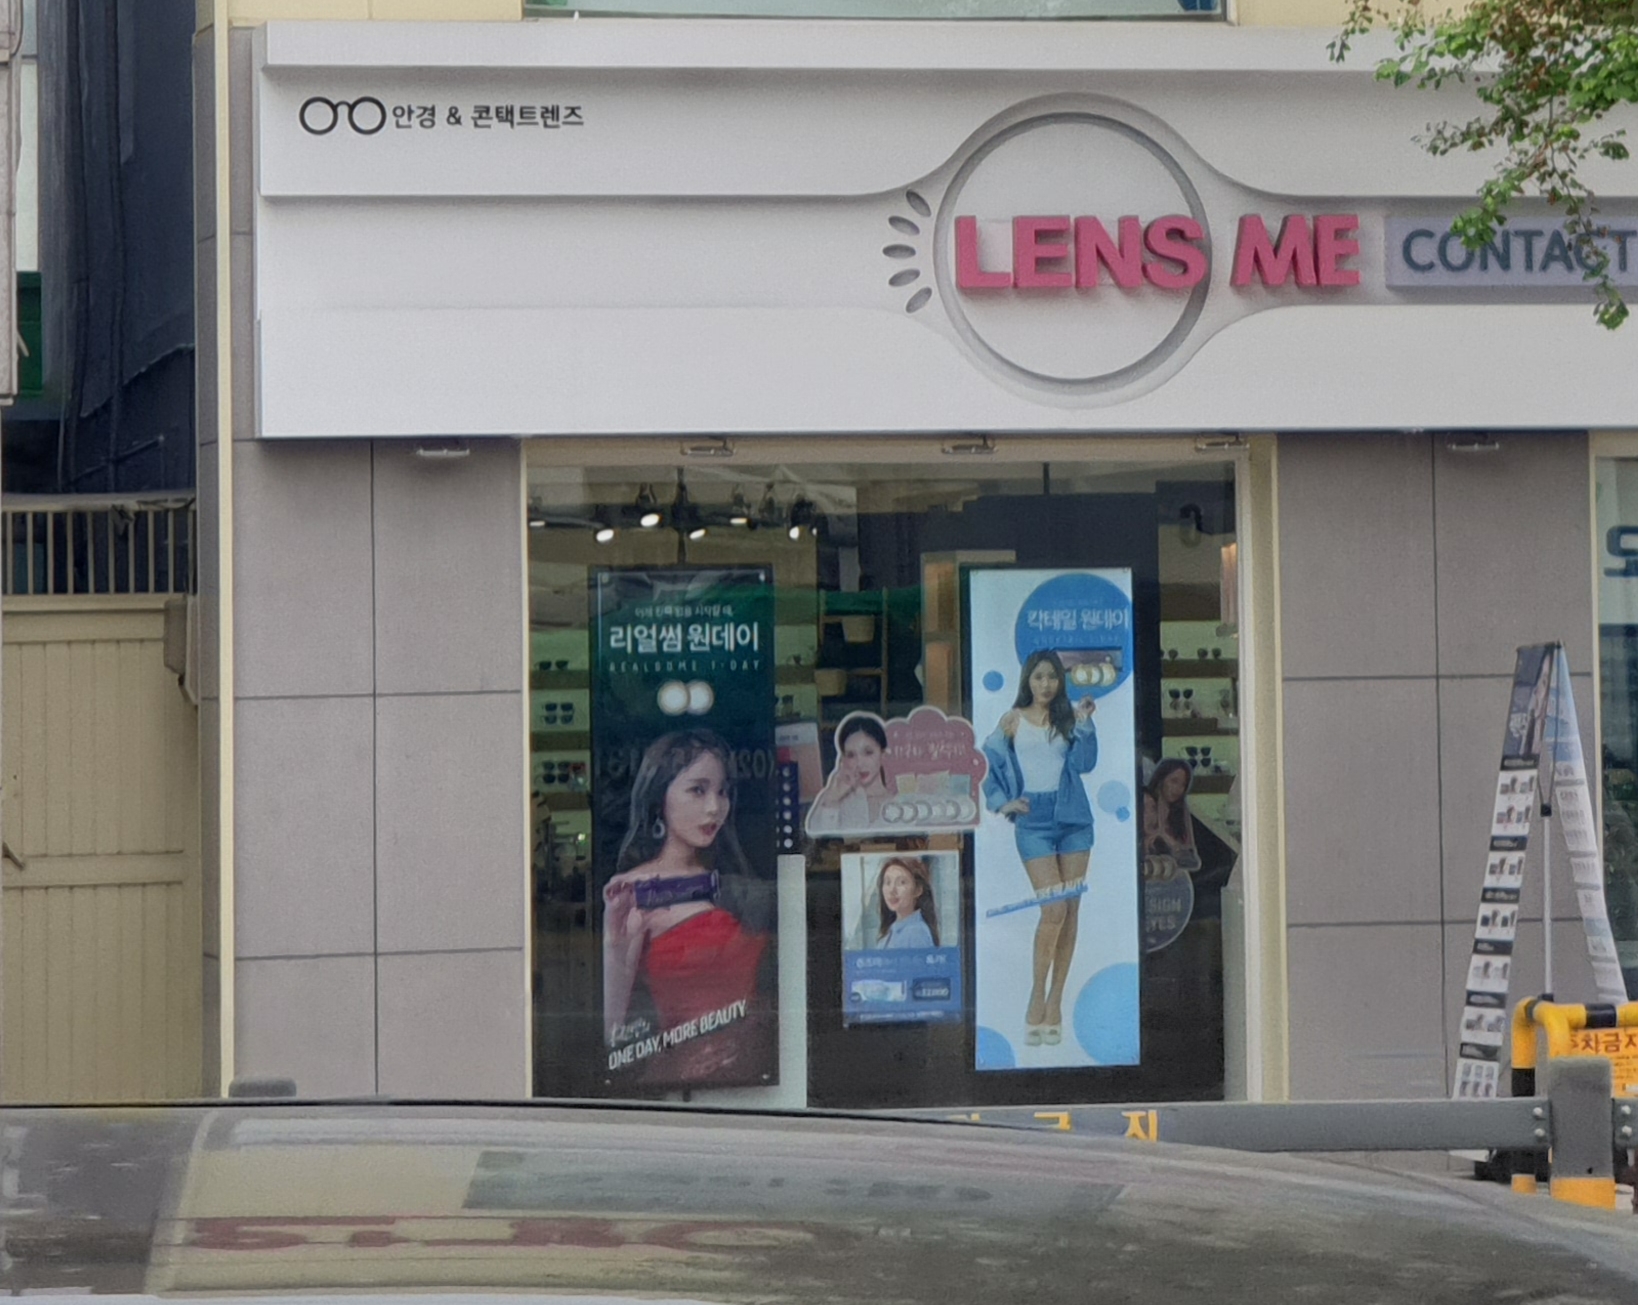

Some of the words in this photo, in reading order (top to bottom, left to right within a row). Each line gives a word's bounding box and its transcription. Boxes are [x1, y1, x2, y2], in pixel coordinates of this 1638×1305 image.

[392, 104, 438, 130] 안경
[446, 106, 463, 127] &
[470, 103, 585, 131] 콘택트렌즈
[954, 214, 1210, 292] LENS
[1229, 212, 1361, 290] ME
[1402, 225, 1636, 275] CONTACT
[609, 621, 683, 654] 리얼썸
[687, 621, 759, 654] 원데이
[608, 1046, 635, 1071] ONE
[662, 1019, 698, 1046] MORE
[699, 998, 747, 1036] BEAUTY
